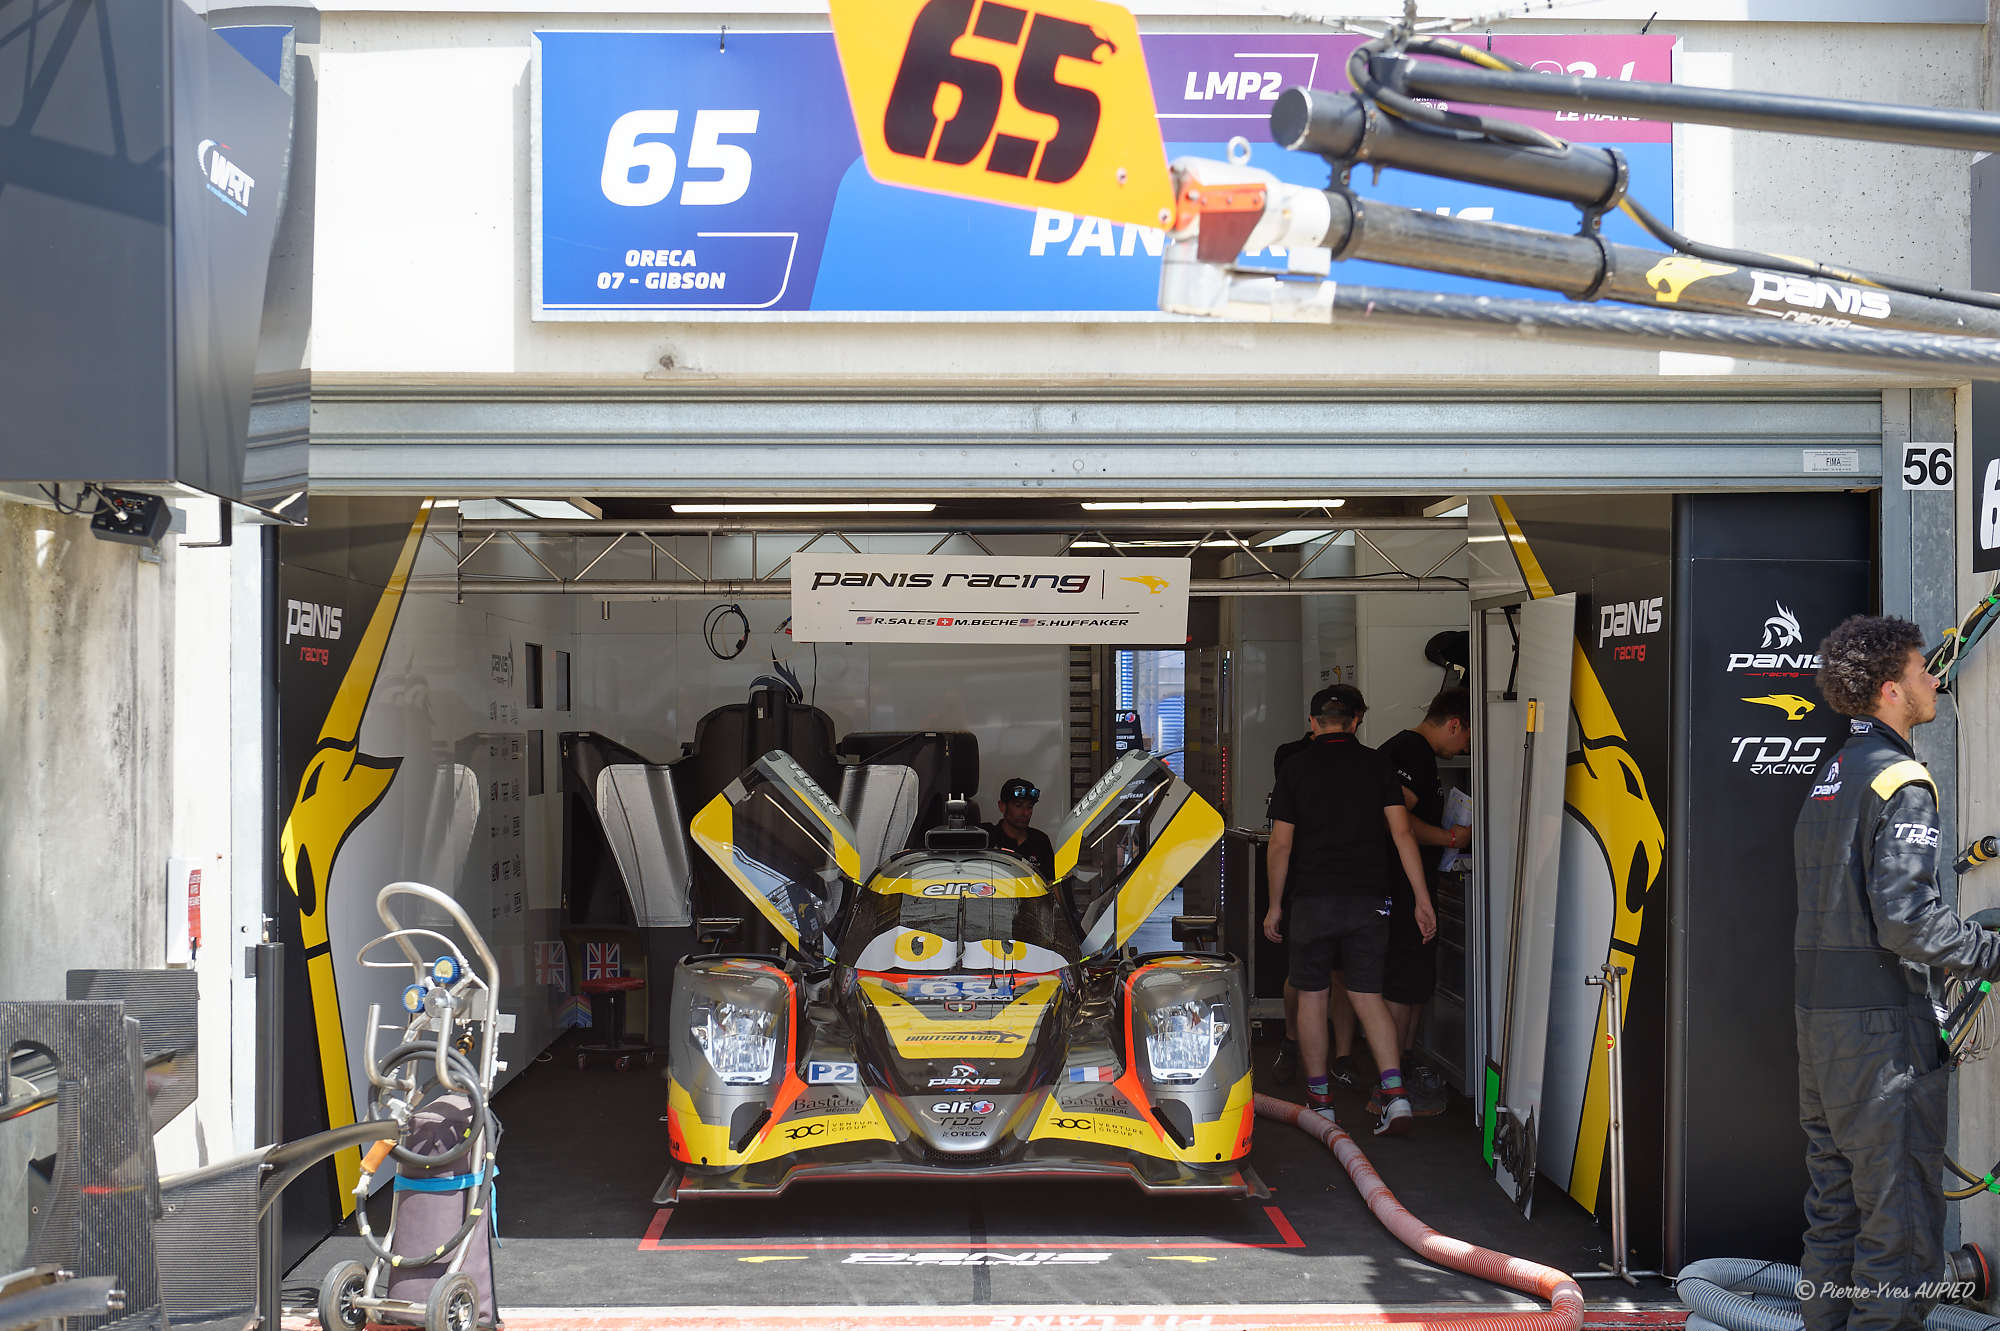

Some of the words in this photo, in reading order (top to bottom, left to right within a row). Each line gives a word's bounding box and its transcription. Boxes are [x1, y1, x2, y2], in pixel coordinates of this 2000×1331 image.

[883, 0, 1117, 185] 65
[1183, 71, 1284, 102] LMP2
[600, 109, 760, 207] 65
[210, 149, 255, 207] WRT
[625, 249, 697, 268] ORECA
[596, 273, 624, 290] 07
[645, 271, 726, 291] GIBSON
[1903, 447, 1953, 486] 56
[942, 572, 1091, 594] racing
[874, 616, 937, 626] R.SALES
[954, 617, 1019, 627] M.BECHE
[1036, 618, 1130, 627] S.HUFFAKER
[1761, 671, 1800, 679] racing
[1731, 736, 1827, 763] TDS
[1750, 763, 1817, 775] RACING
[1894, 823, 1940, 840] TDS
[1905, 836, 1939, 848] RACING
[920, 981, 999, 997] 65
[811, 1063, 856, 1081] P2
[832, 1119, 879, 1127] VENTURE
[939, 1116, 987, 1126] TDS
[1050, 1117, 1092, 1131] ROC
[1098, 1122, 1145, 1136] VENTURE
[785, 1123, 825, 1140] ROC
[1098, 1127, 1133, 1137] GROUP
